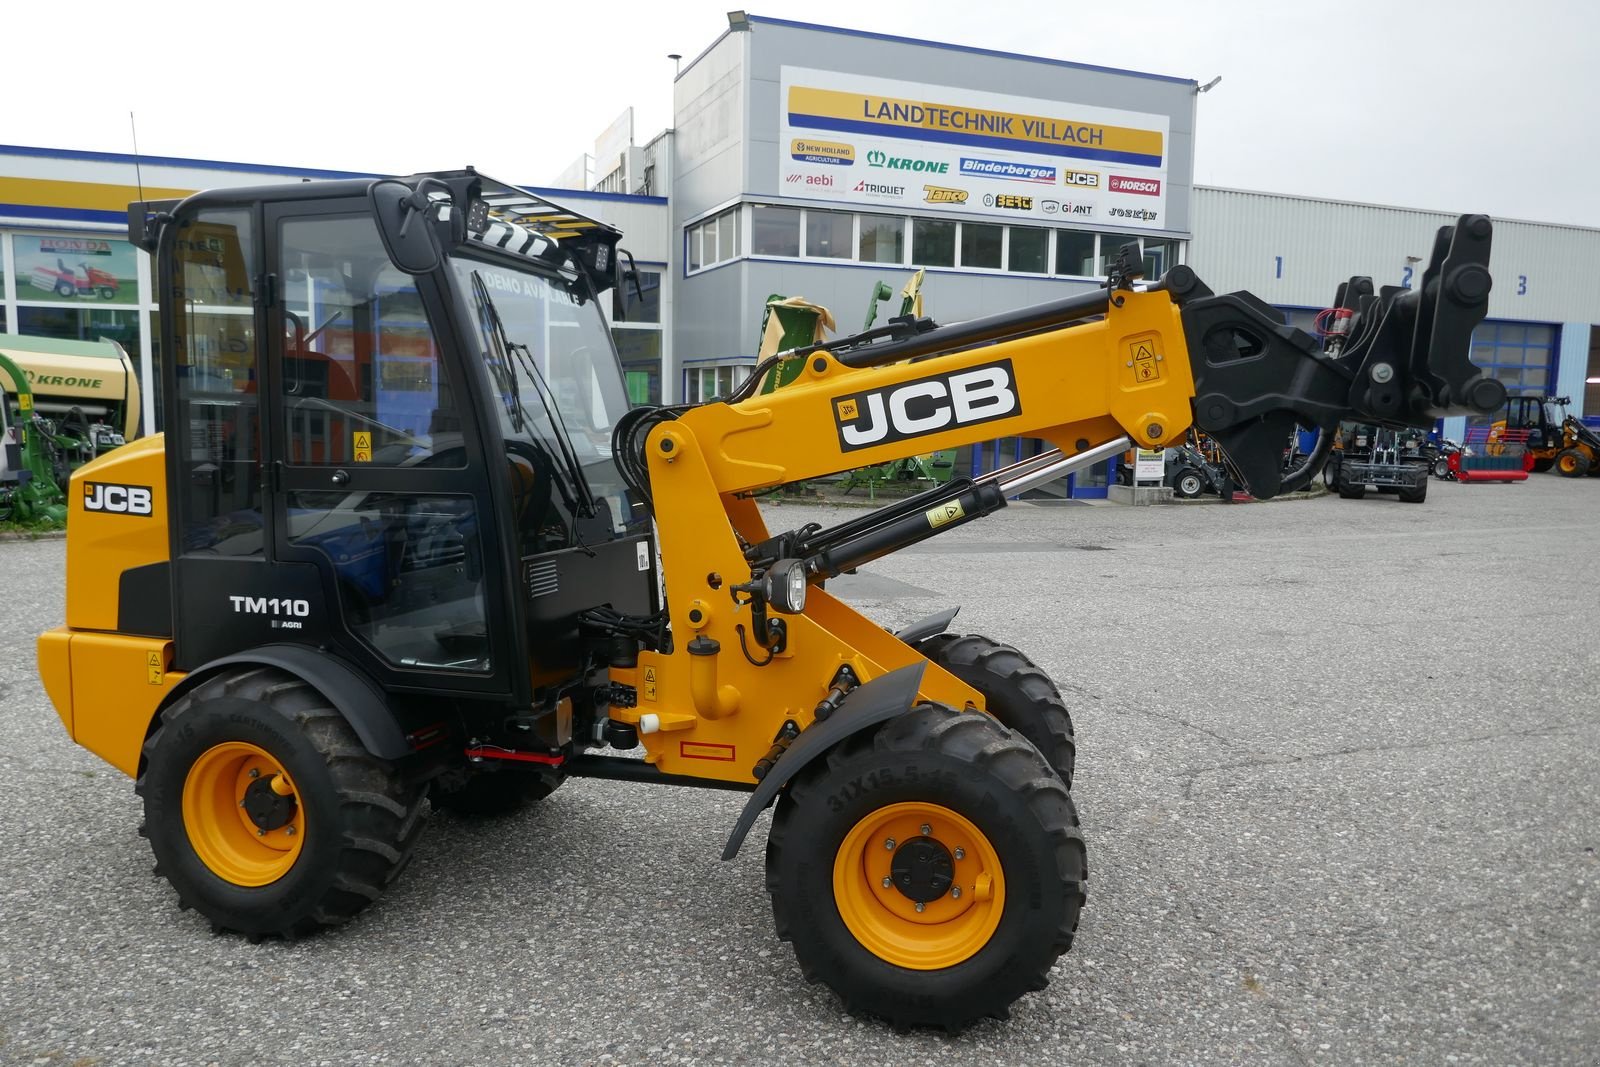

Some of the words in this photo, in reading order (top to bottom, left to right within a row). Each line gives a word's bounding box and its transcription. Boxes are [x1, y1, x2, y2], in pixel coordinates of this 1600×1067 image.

[864, 99, 1013, 135] LANDTECHNIK
[1022, 119, 1103, 145] VILLACH
[806, 145, 820, 153] NEW
[821, 146, 850, 156] HOLLAND
[805, 156, 840, 164] AGRICULTURE
[887, 157, 950, 174] KRONE
[963, 160, 1054, 178] Binderberger
[806, 174, 833, 187] aebi
[1066, 173, 1098, 186] JCB
[1120, 180, 1158, 193] HORSCH
[923, 185, 969, 204] Tanco
[40, 239, 112, 251] HONDA
[1275, 256, 1283, 279] 1
[484, 271, 521, 294] DEMO
[1401, 266, 1413, 288] 2
[1517, 275, 1527, 295] 3
[37, 375, 103, 389] KRONE
[842, 366, 1015, 446] JCB
[84, 484, 152, 514] JCB
[229, 595, 310, 617] TM110
[281, 621, 302, 629] AGRI
